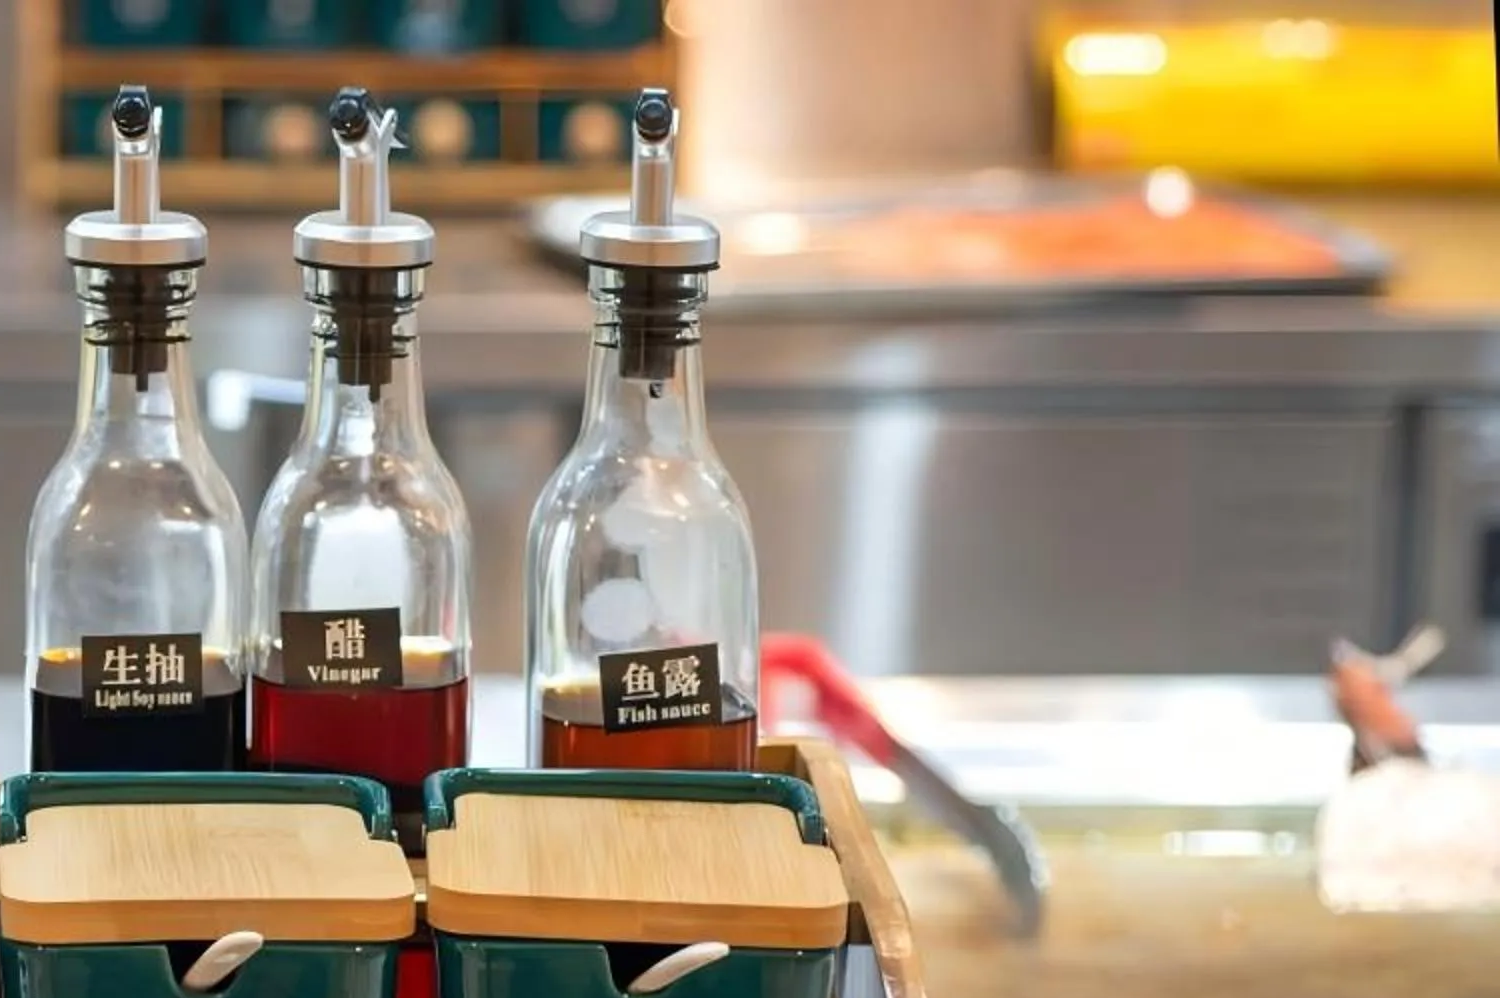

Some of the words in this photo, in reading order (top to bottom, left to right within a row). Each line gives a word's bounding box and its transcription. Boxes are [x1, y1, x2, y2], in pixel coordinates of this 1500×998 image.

[324, 617, 365, 659] 醋
[101, 643, 185, 685] 生抽
[307, 665, 382, 684] Vinegar
[621, 655, 700, 700] 鱼露
[618, 703, 659, 724] Fish
[661, 703, 712, 720] sauce
